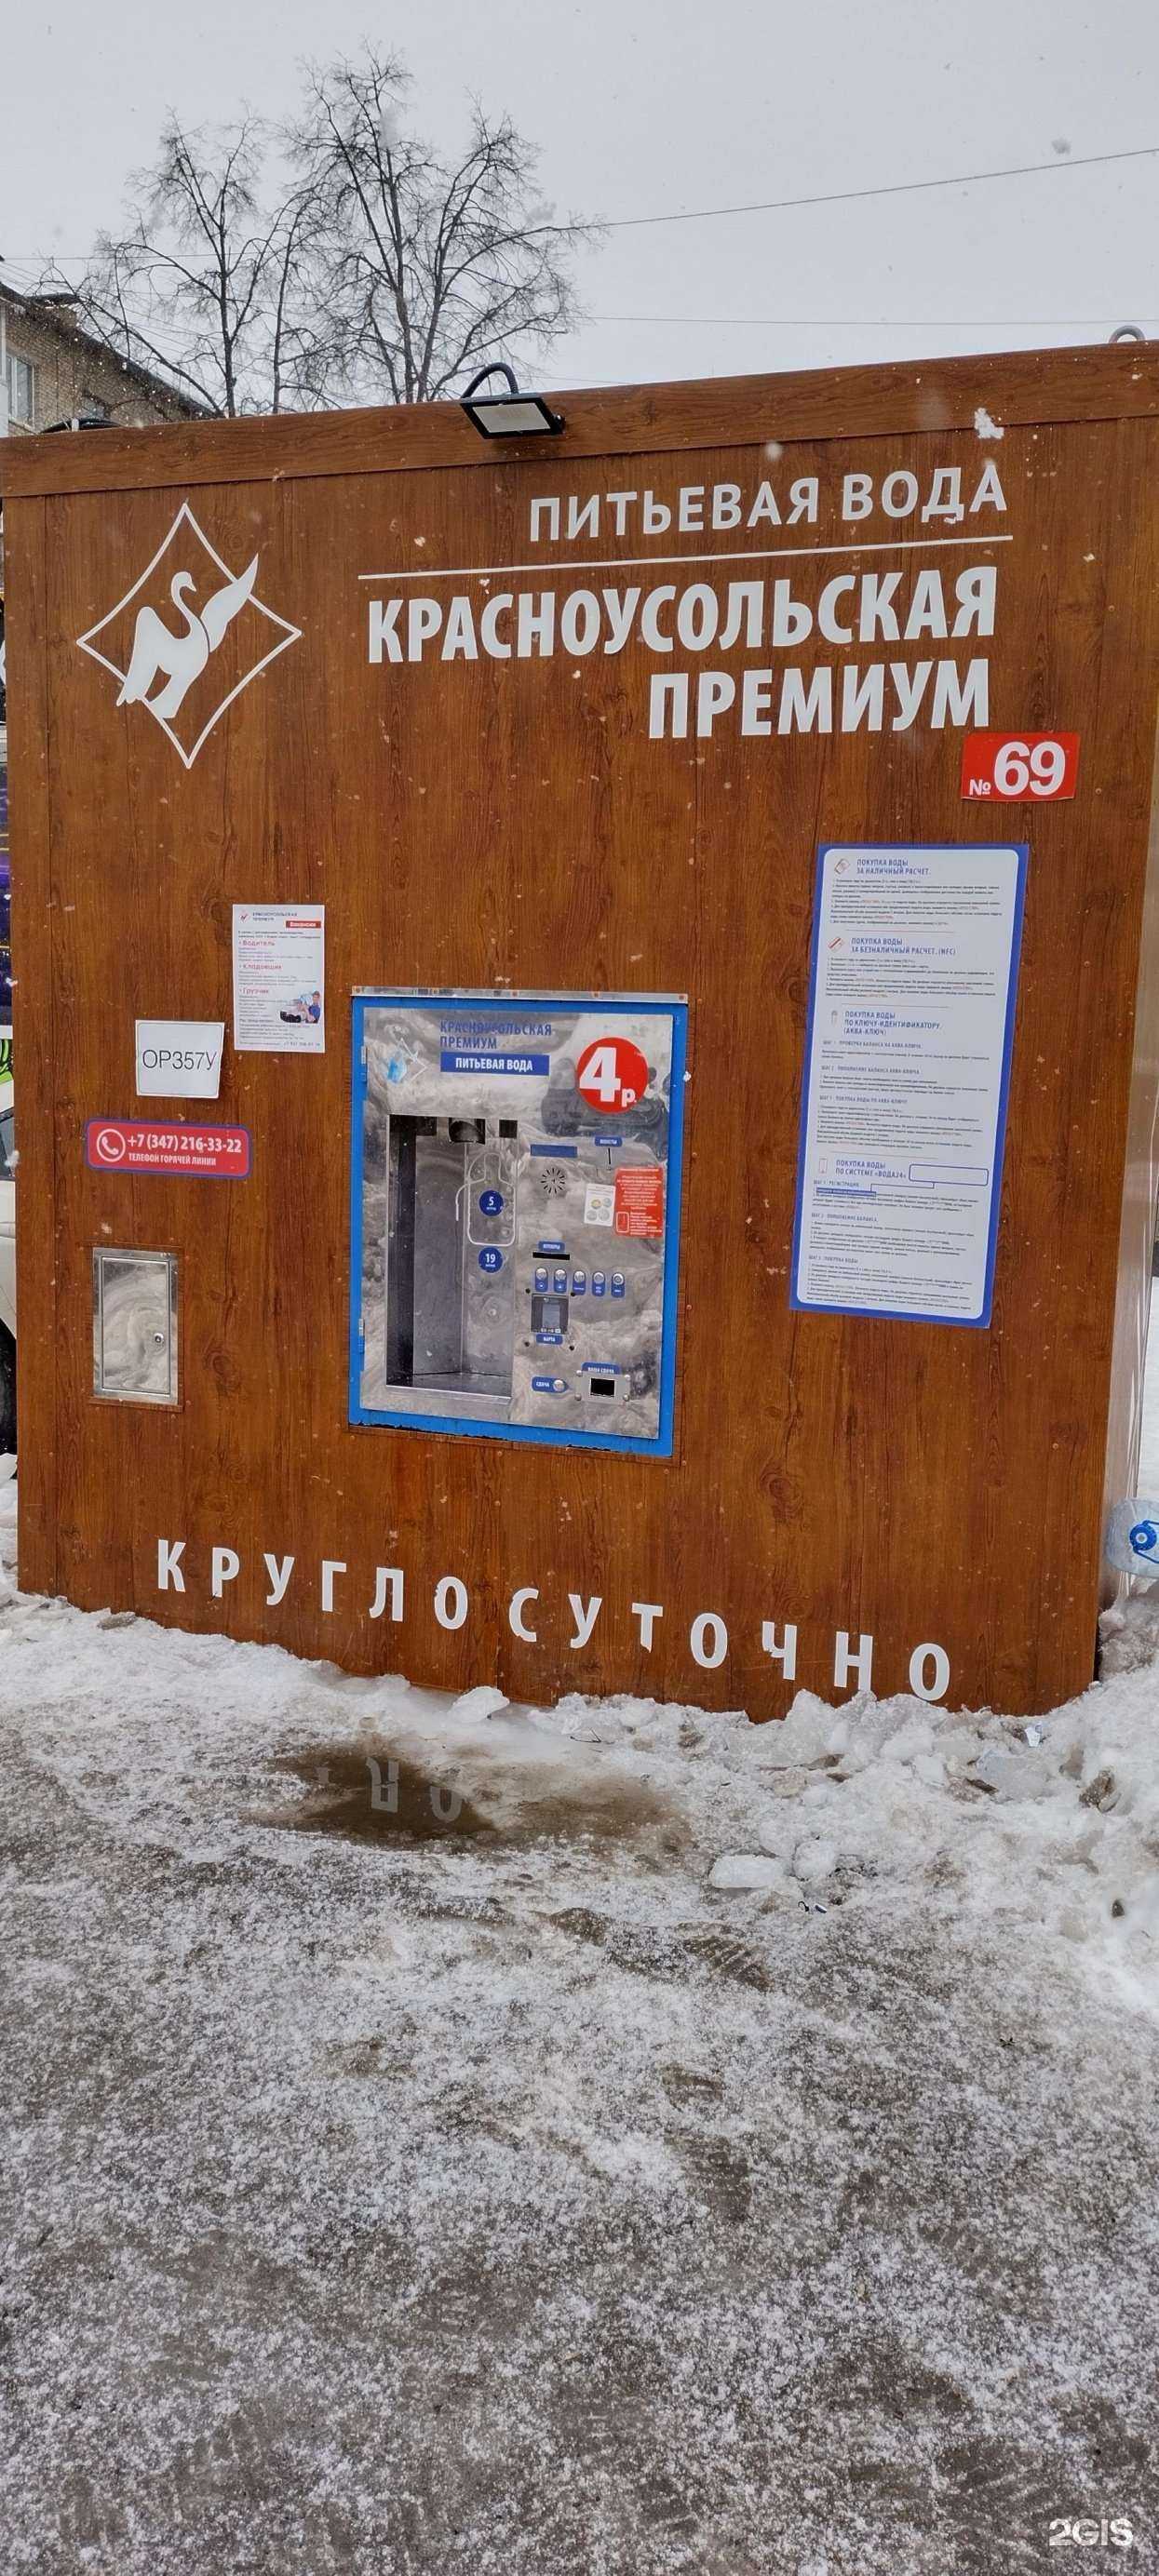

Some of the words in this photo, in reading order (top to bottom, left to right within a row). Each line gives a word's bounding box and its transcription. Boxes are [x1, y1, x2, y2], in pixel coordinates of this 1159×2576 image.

[530, 477, 819, 543] ПИТЬЕВАЯ
[842, 462, 1007, 524] ВОДА
[368, 567, 997, 664] КРАСНОУСОЛЬСКАЯ
[649, 658, 989, 739] ПРЕМИУМ
[994, 741, 1066, 796] 69
[439, 1036, 497, 1050] ПРЕМИУМ
[455, 1057, 505, 1070] ПИТЬЕВАЯ
[506, 1059, 532, 1072] ВОДА
[128, 1134, 144, 1147] +7
[147, 1134, 179, 1151] (347)
[180, 1135, 242, 1153] 216-33-22
[128, 1153, 160, 1162] ТЕЛЕФОН
[160, 1154, 190, 1164] ГОРЯЧЕЙ
[192, 1157, 216, 1166] ЛИНИИ
[866, 1161, 885, 1169] ВОДЫ
[489, 1196, 494, 1206] 5
[485, 1254, 496, 1264] 19
[156, 1538, 950, 1701] КРУГЛОСУТОЧНО
